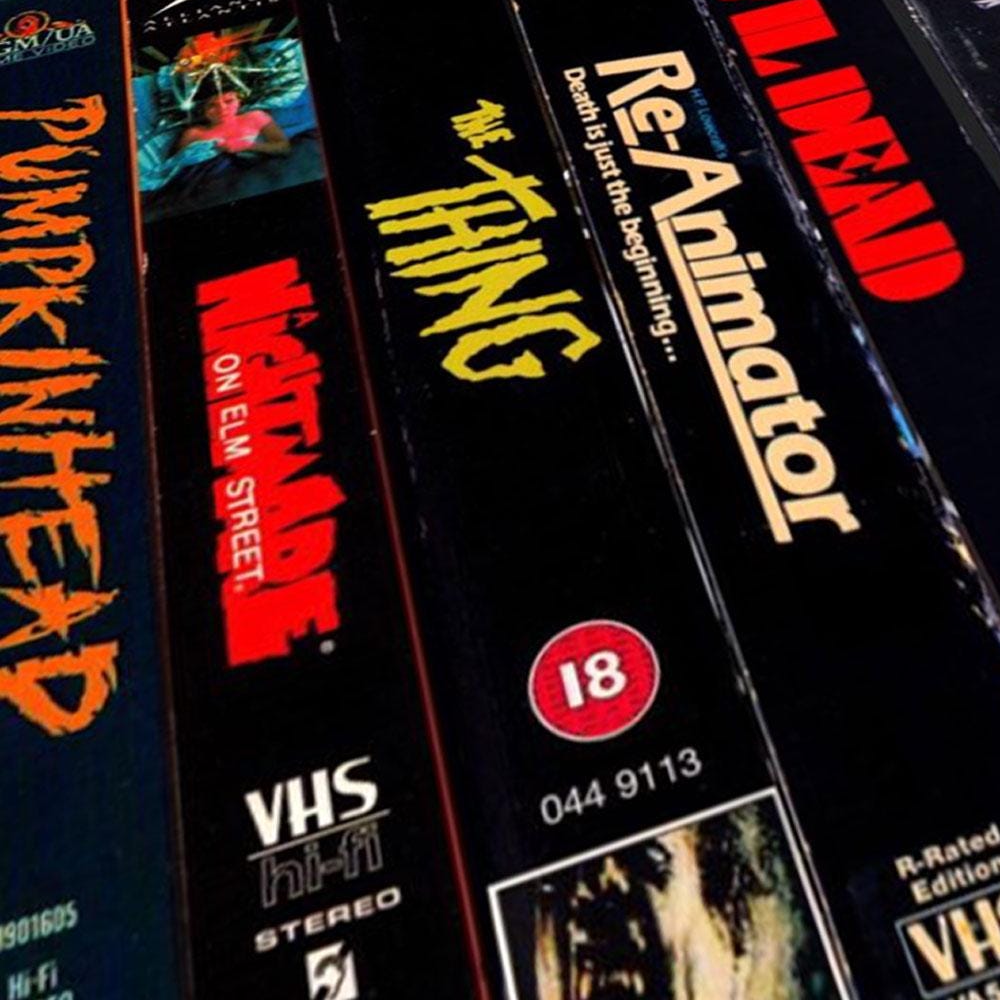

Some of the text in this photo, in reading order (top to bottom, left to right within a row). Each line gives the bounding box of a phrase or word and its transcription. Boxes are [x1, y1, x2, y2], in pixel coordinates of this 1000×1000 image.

[562, 66, 601, 124] Death
[583, 140, 622, 180] just
[584, 123, 608, 141] is
[606, 178, 634, 217] the
[764, 64, 966, 301] DEAD
[364, 154, 602, 383] THING
[212, 352, 242, 394] ON
[0, 93, 119, 737] PUMPKINHEAD
[219, 403, 252, 462] ELM
[194, 256, 348, 669] NIGHTMARE
[558, 650, 628, 711] 18
[243, 754, 379, 847] VHS
[539, 746, 704, 826] 044 9113
[253, 885, 402, 954] STEREO
